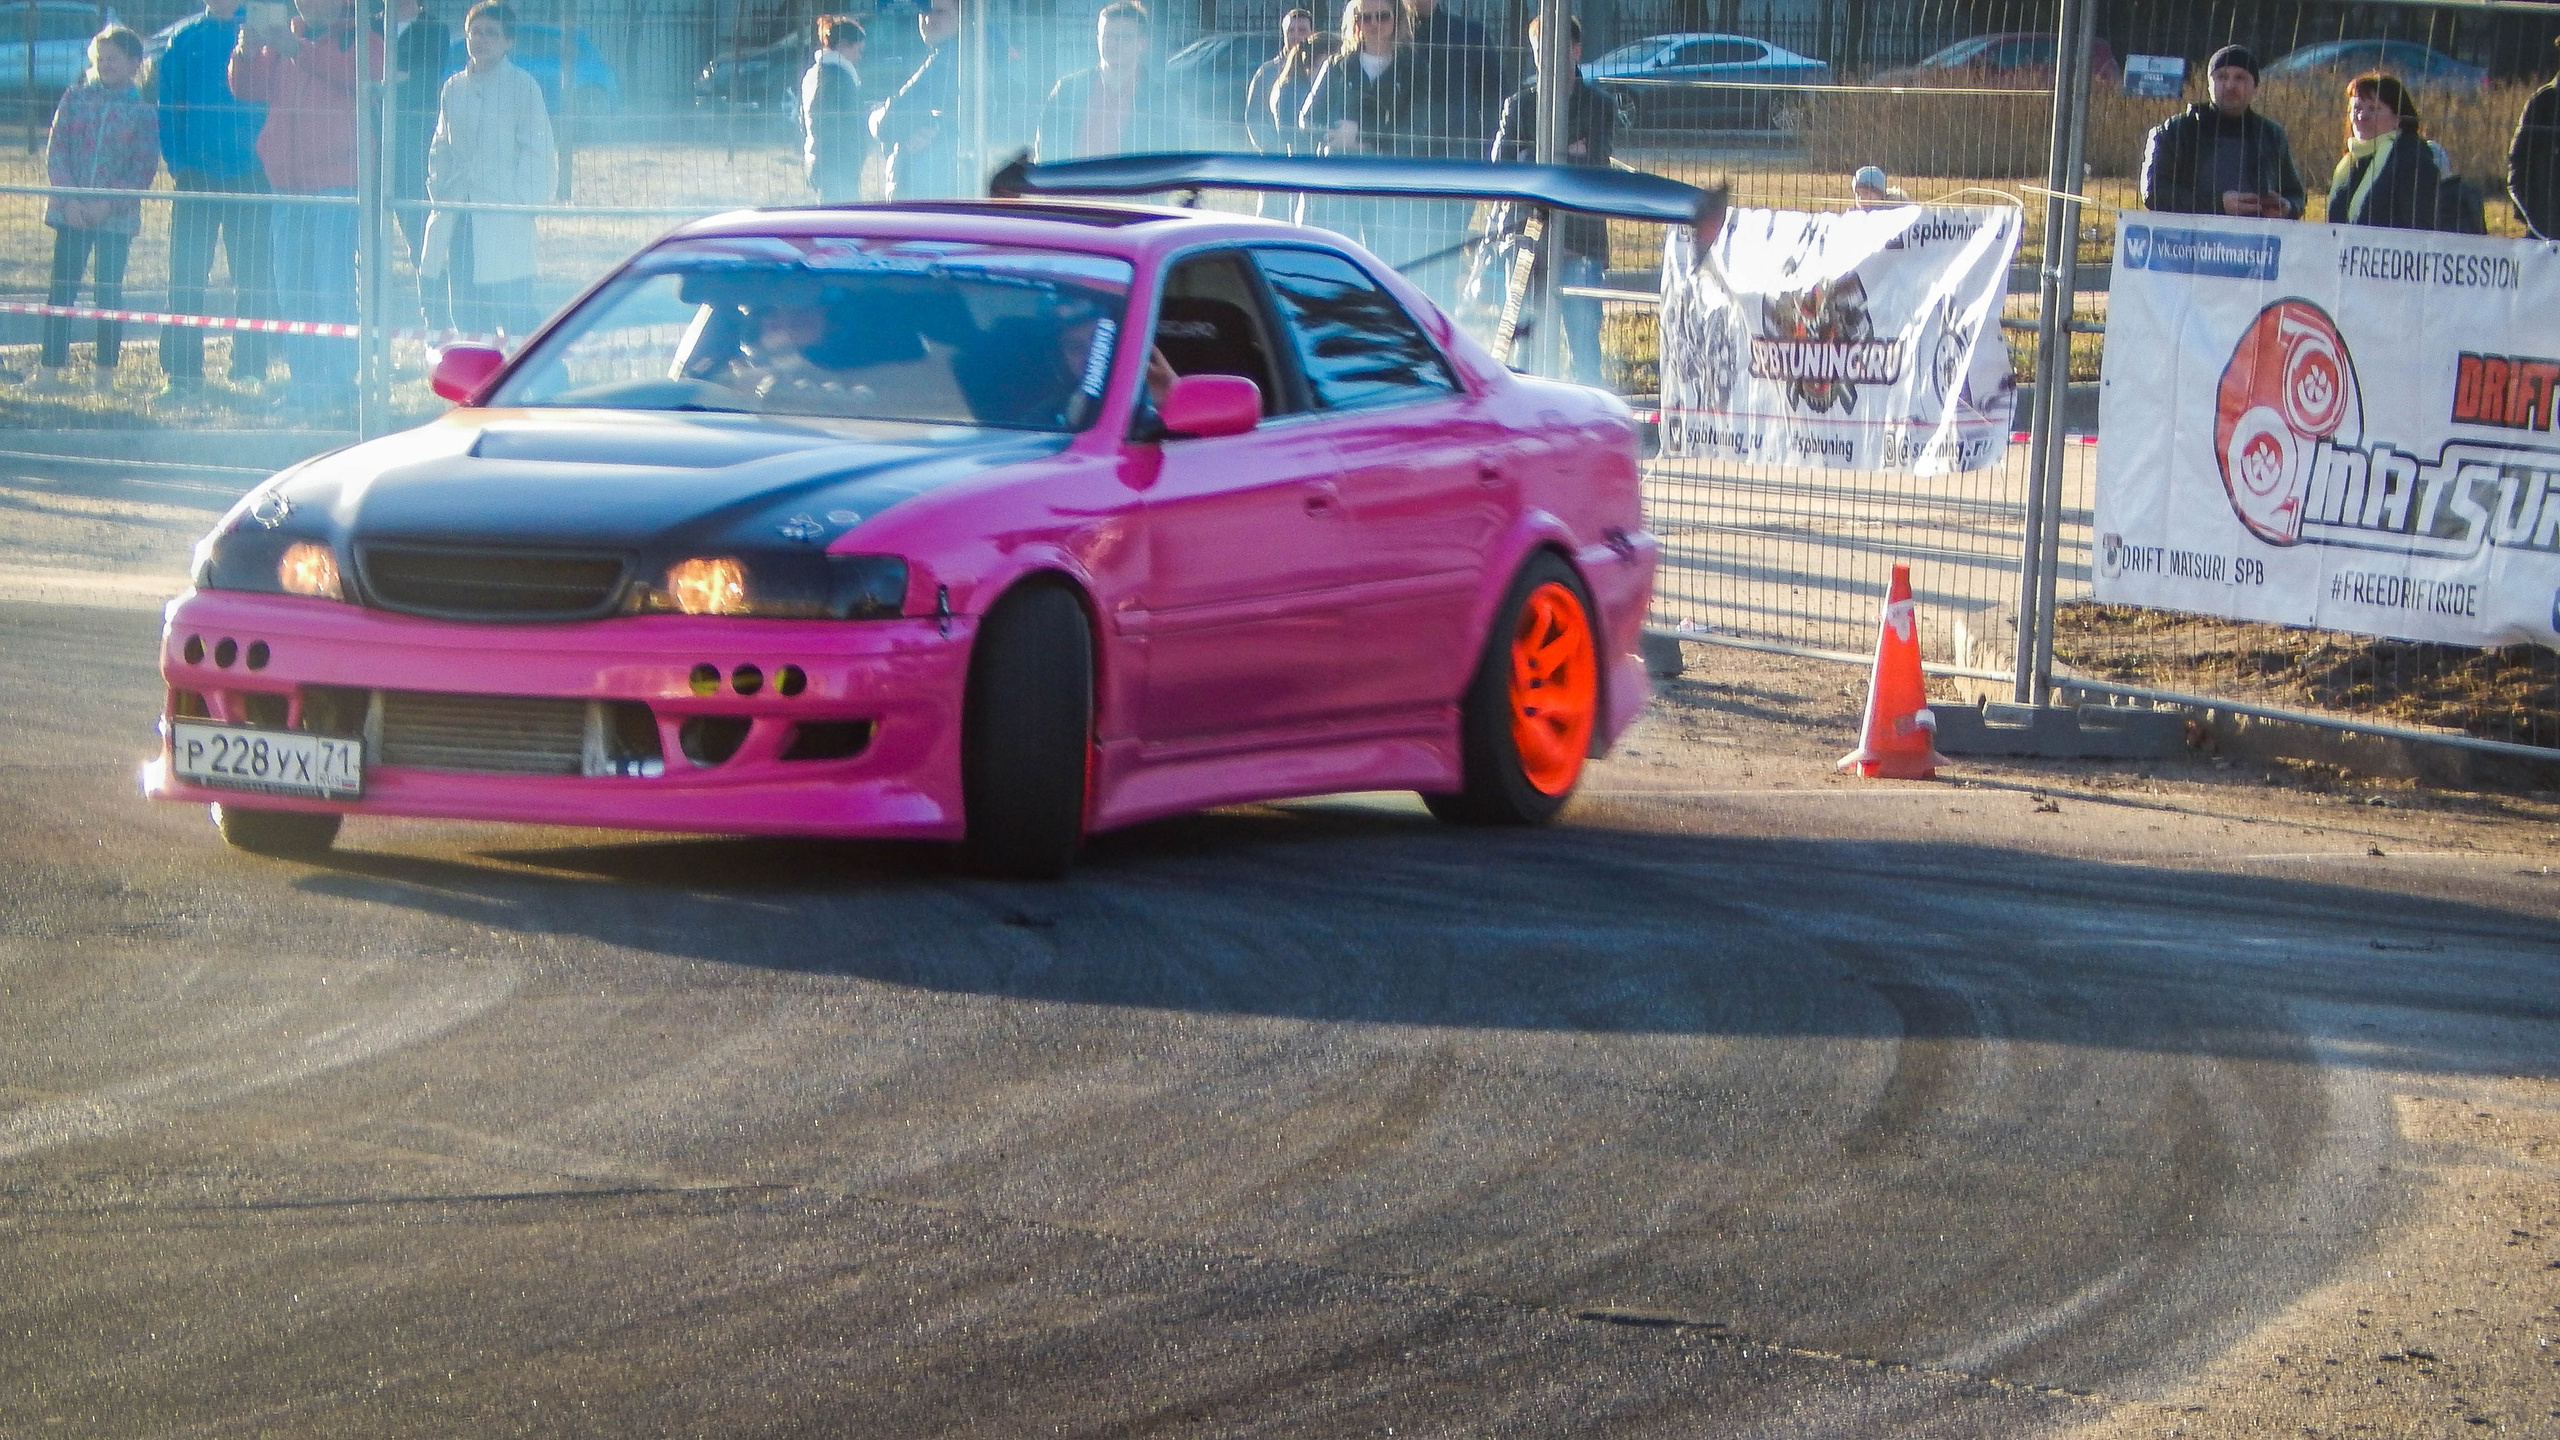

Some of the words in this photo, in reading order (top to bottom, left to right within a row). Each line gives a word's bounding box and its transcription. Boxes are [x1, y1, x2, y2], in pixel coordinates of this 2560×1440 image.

[2339, 245, 2520, 290] #FREEDRIFTSESSION
[2452, 351, 2560, 432] DRIFT
[2122, 544, 2264, 586] DRIFT_MATSURI_SPB
[2331, 570, 2477, 617] #FREEDRIFTRIDE
[321, 741, 349, 776] 71
